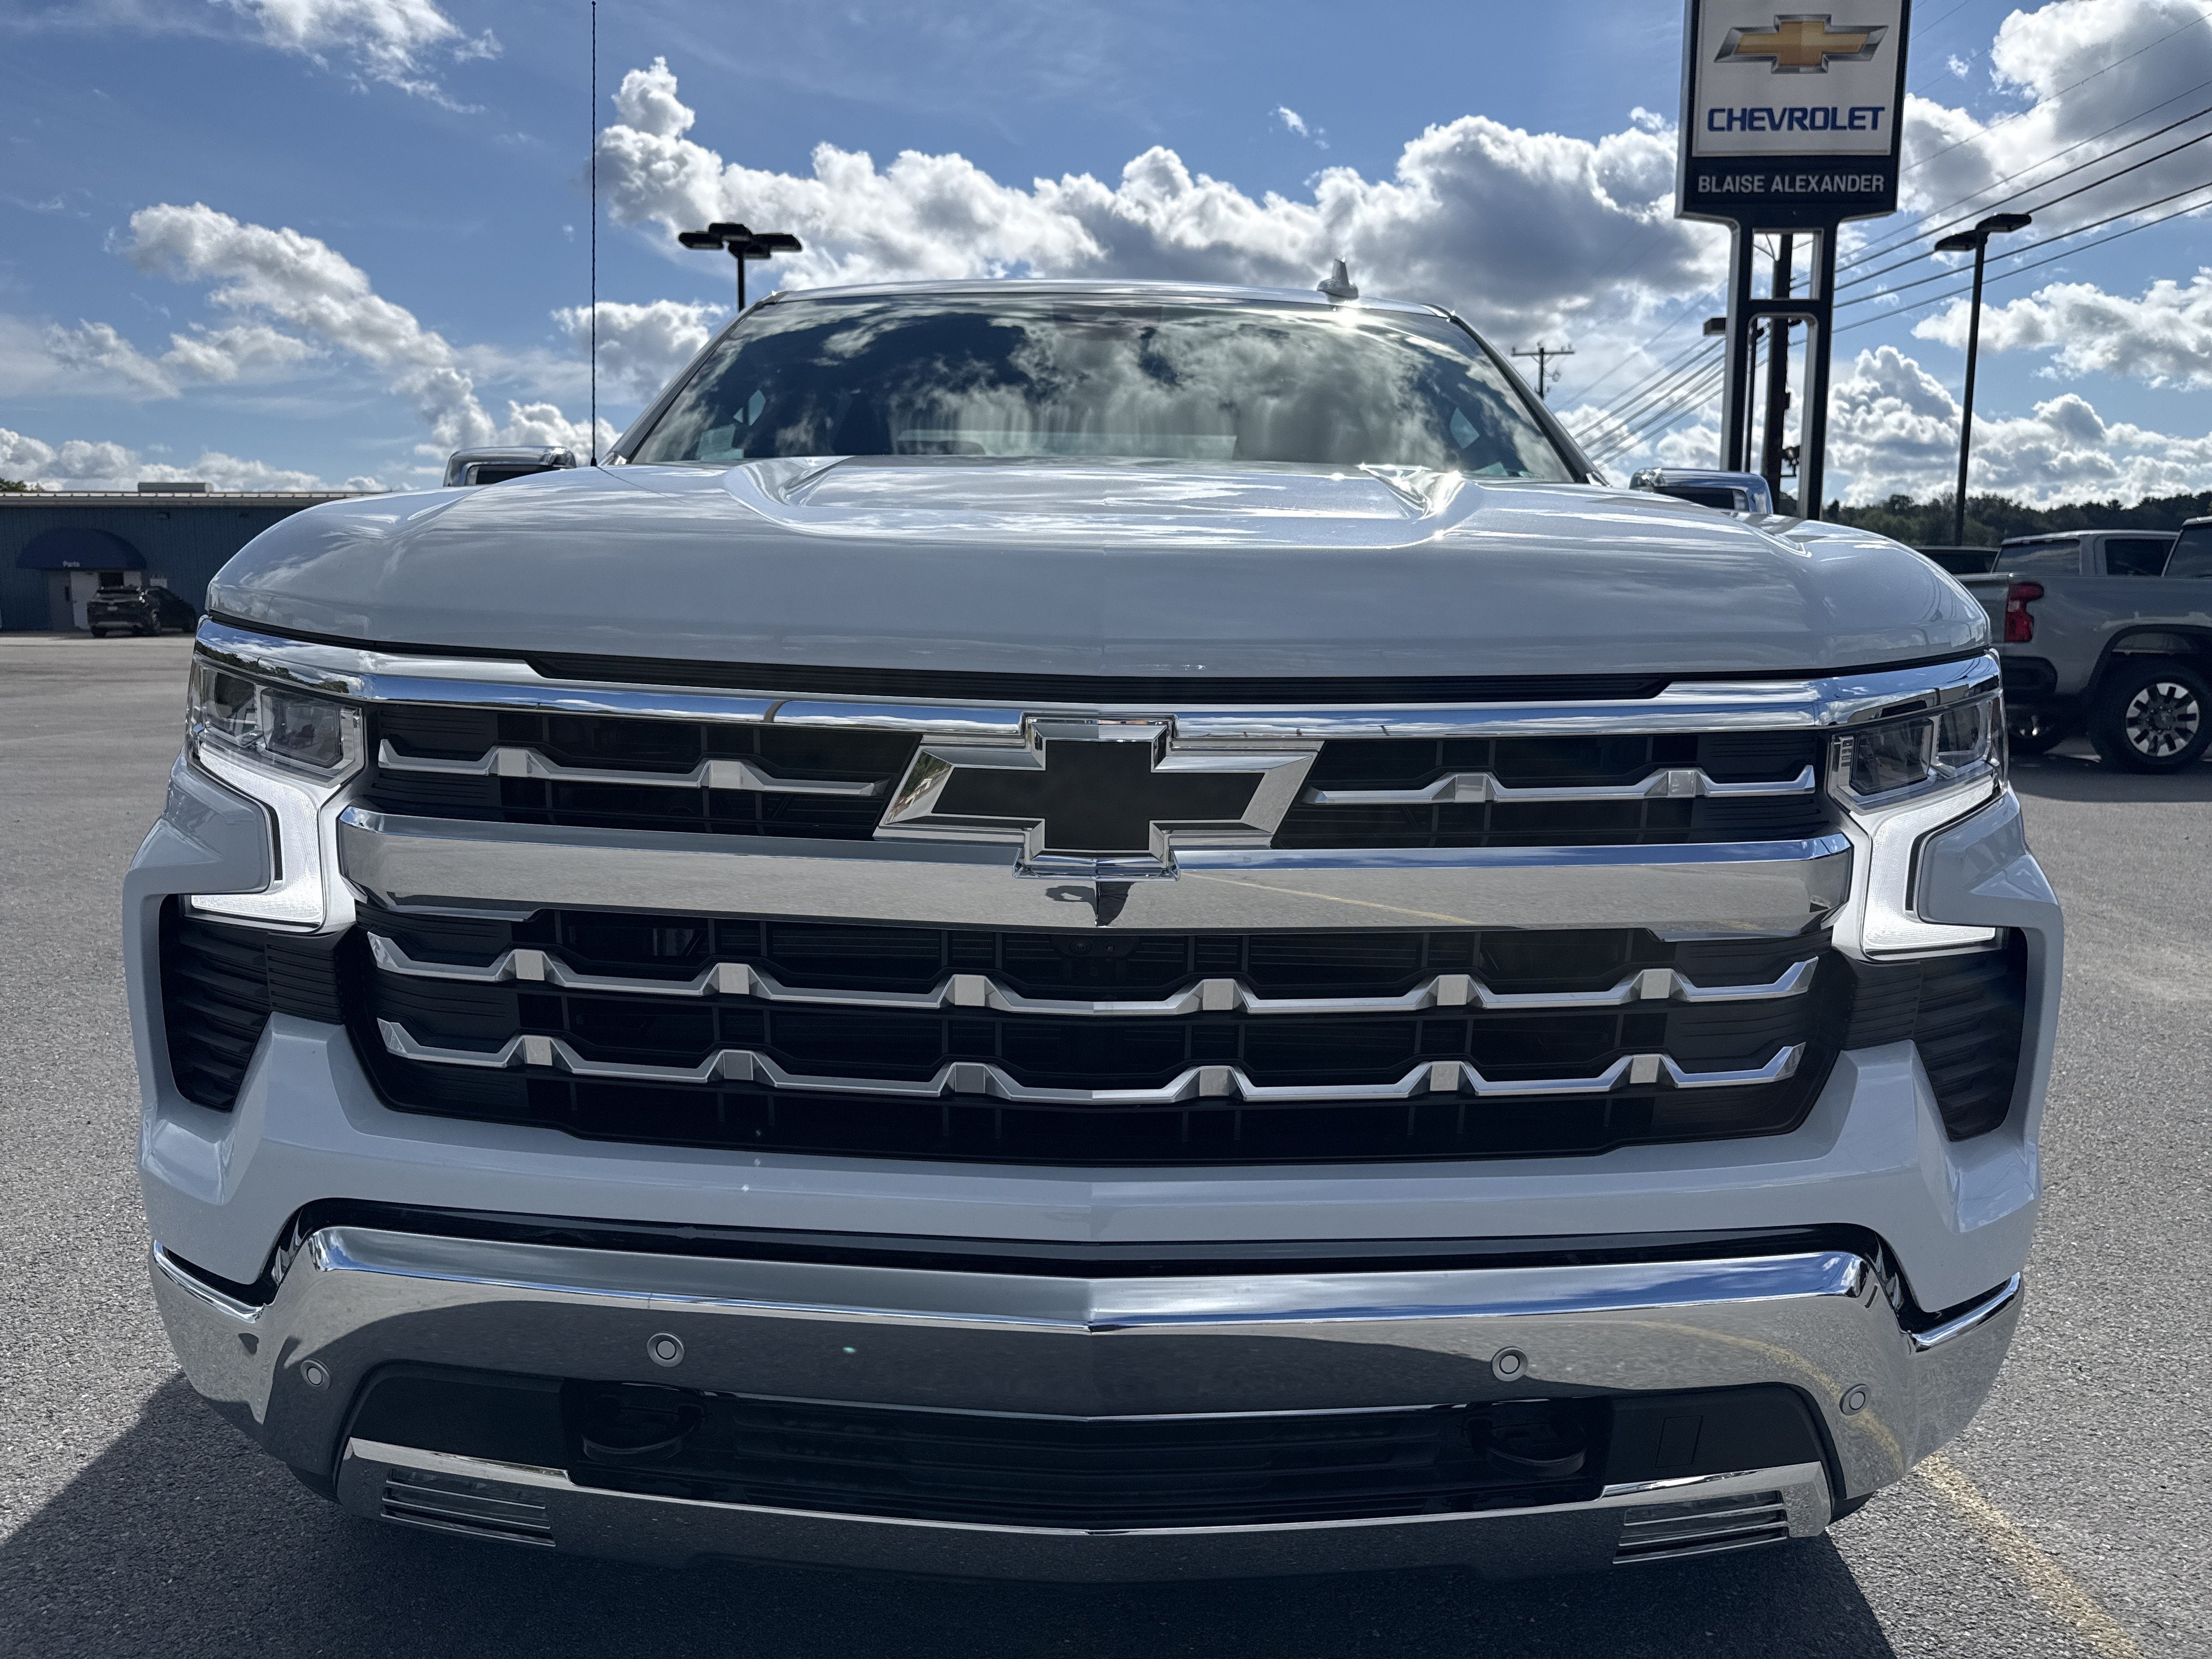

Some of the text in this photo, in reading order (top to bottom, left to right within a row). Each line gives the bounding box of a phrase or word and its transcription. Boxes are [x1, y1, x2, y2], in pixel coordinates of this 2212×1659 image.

[1707, 106, 1885, 132] CHEVROLET
[1697, 174, 1884, 194] BLAISE ALEXANDER
